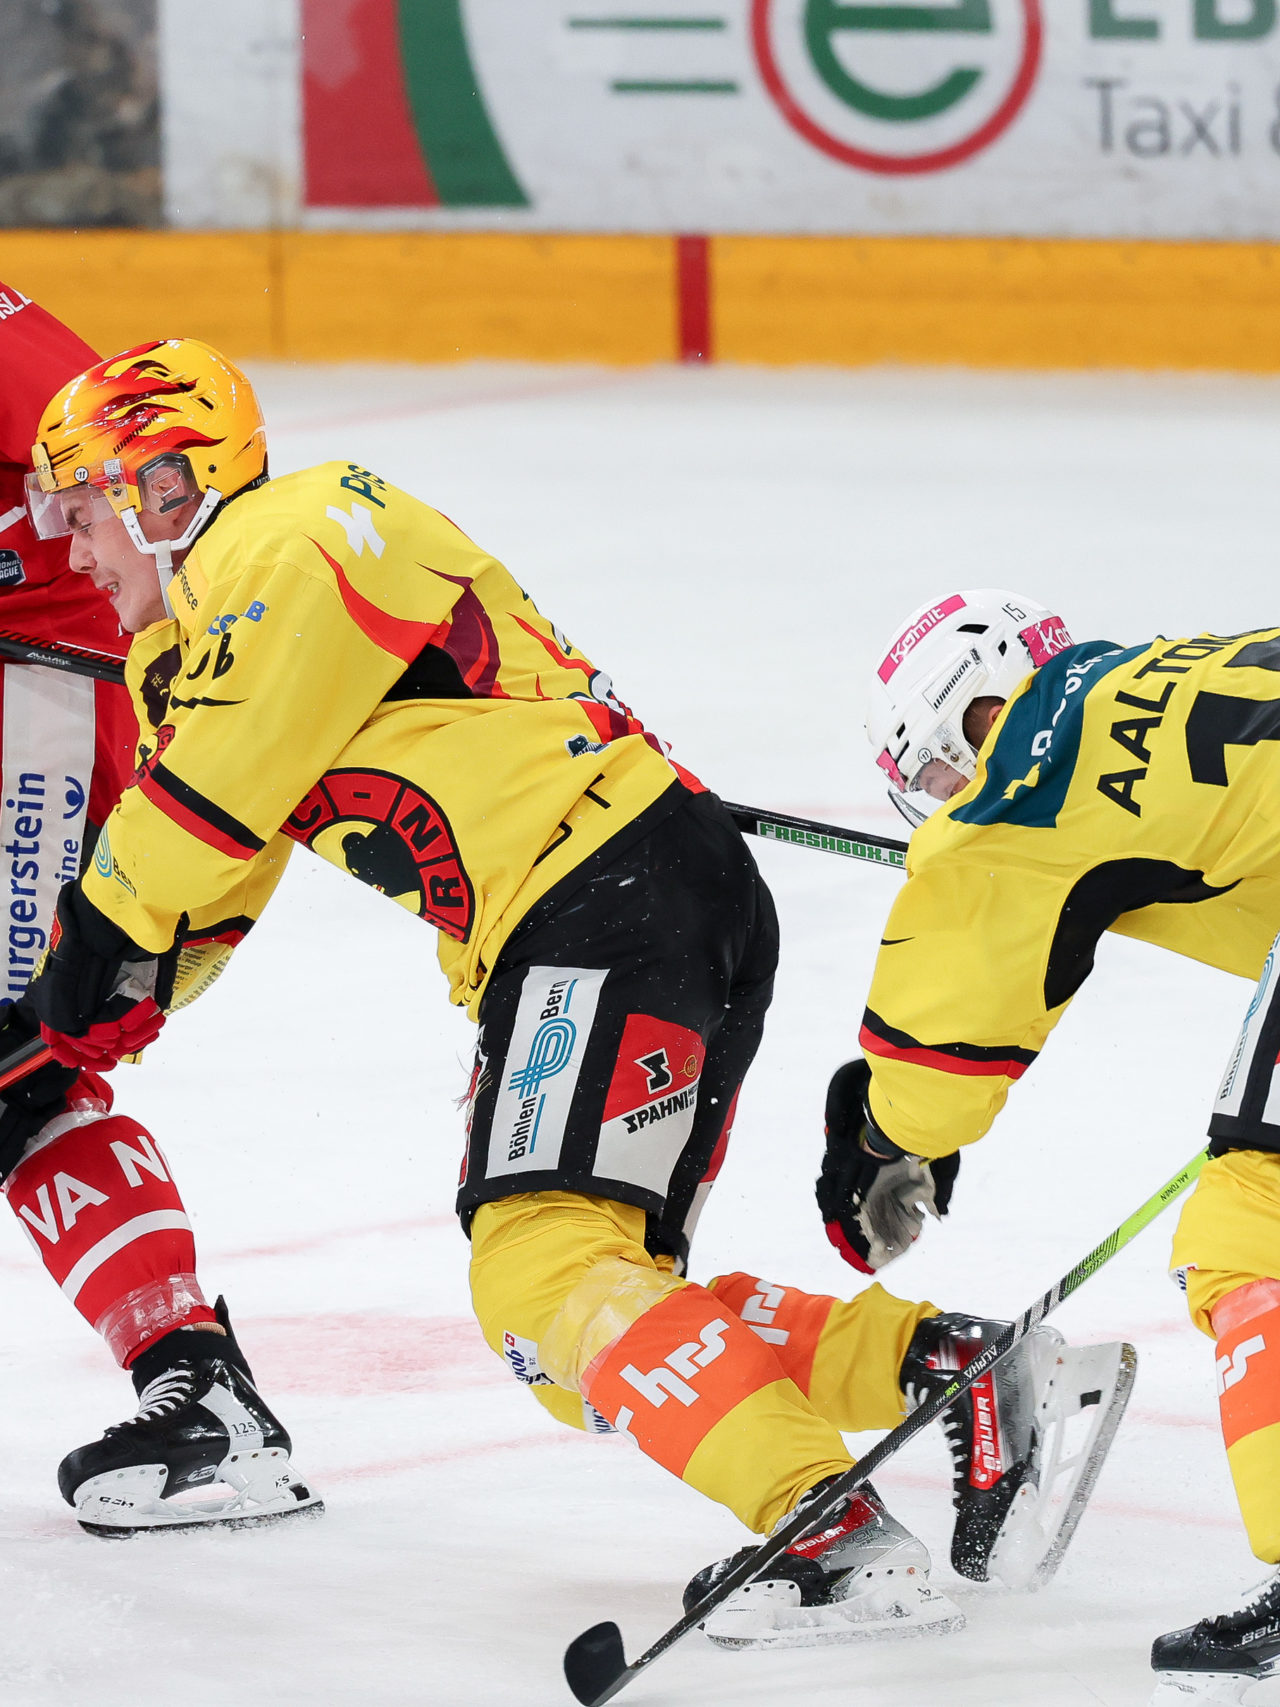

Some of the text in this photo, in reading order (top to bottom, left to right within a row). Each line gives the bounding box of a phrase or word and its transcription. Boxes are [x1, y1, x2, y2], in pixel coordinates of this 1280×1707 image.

[1083, 77, 1242, 159] Taxi
[1001, 602, 1027, 623] 15
[932, 659, 972, 711] WARRIOR
[759, 822, 907, 867] FRESHBOX.C
[539, 978, 570, 1021] Bern
[507, 1096, 538, 1162] Böhlen
[622, 1089, 690, 1135] SPAHNI
[620, 1317, 730, 1408] hrs
[963, 1344, 998, 1380] ALPHA
[230, 1421, 257, 1435] 125
